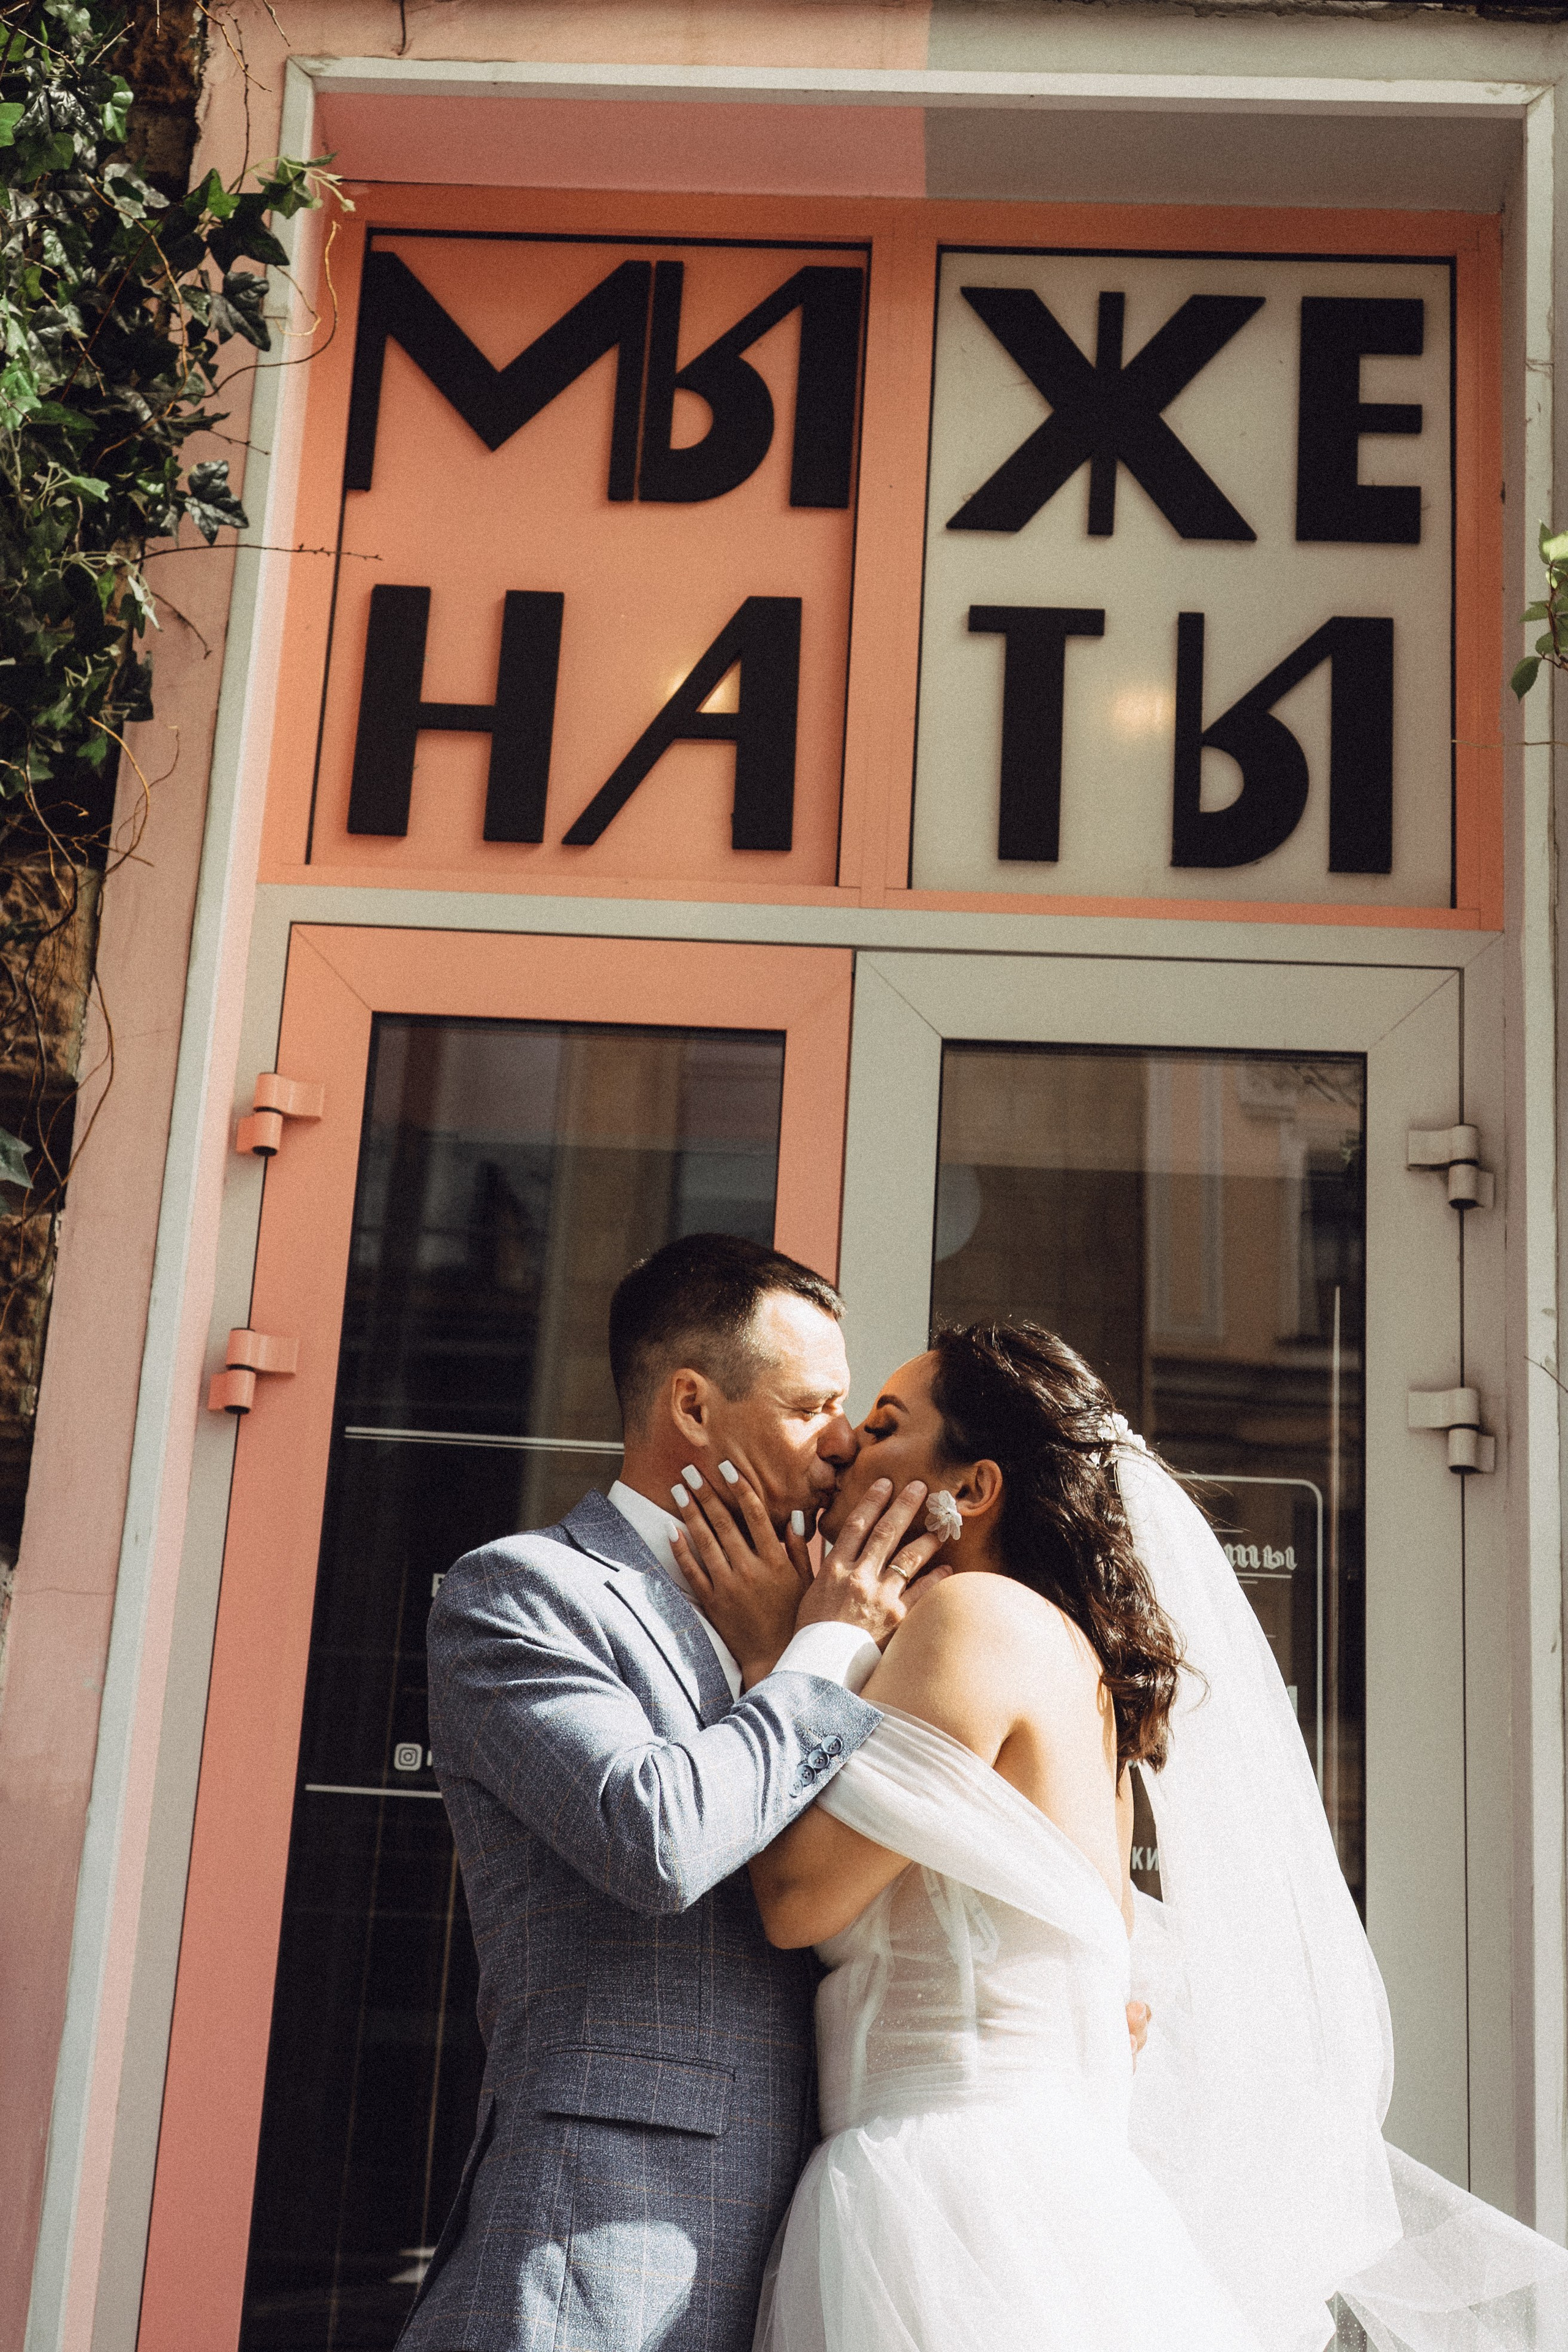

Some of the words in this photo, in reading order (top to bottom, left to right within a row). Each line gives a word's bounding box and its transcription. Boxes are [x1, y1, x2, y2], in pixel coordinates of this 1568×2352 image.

[344, 251, 864, 510] МЫ
[946, 285, 1424, 545] ЖЕ
[347, 583, 802, 851] НА
[967, 605, 1394, 875] ТЫ
